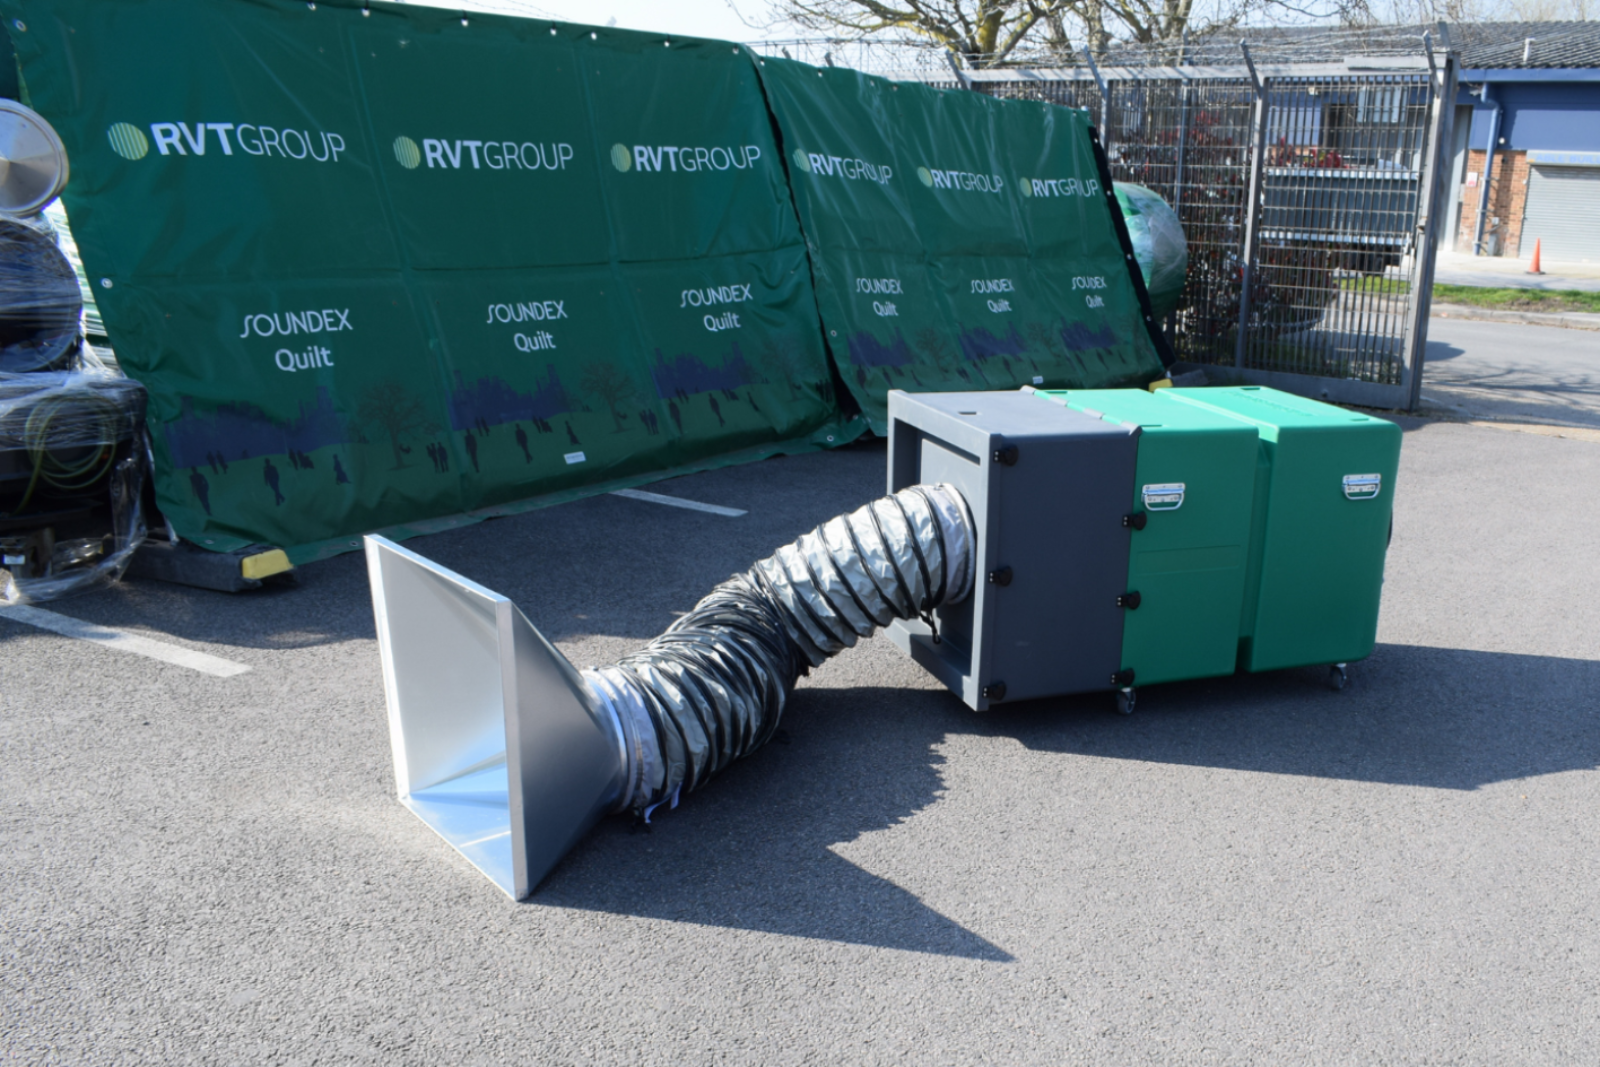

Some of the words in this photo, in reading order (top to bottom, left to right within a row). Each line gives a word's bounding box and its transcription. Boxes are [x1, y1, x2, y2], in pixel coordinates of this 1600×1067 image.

[150, 121, 346, 164] RVTGROUP
[422, 138, 574, 171] RVTGROUP
[633, 144, 761, 172] RVTGROUP
[680, 282, 753, 308] SOUNDEX
[856, 277, 904, 295] SOUNDEX
[970, 278, 1016, 294] SOUNDEX
[486, 299, 568, 324] SOUNDEX
[873, 300, 899, 317] Quilt
[986, 298, 1013, 315] Quilt
[239, 308, 354, 339] SOUNDEX
[703, 311, 741, 332] Quilt
[513, 330, 557, 353] Quilt
[274, 345, 335, 373] Quilt
